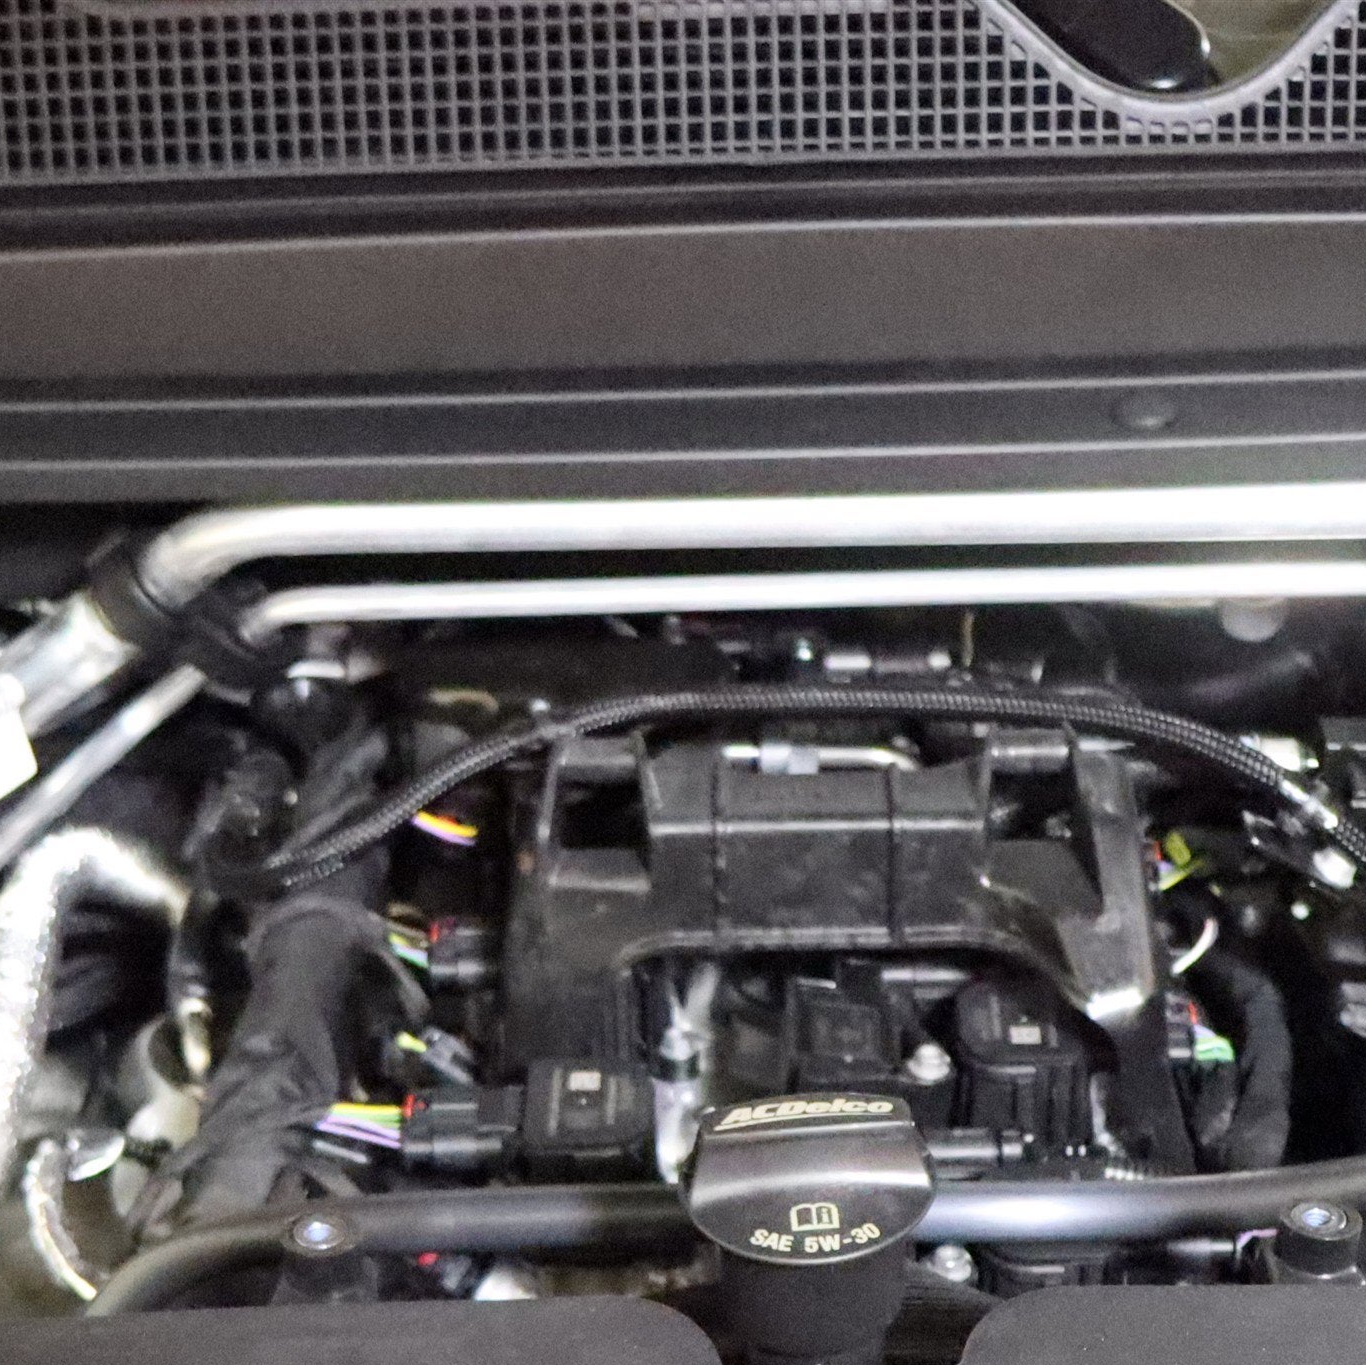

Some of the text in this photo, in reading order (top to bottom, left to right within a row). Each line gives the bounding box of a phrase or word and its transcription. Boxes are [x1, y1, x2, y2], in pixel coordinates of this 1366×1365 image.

[719, 1098, 894, 1126] ACDelco
[750, 1223, 881, 1253] SAE 5W-30
